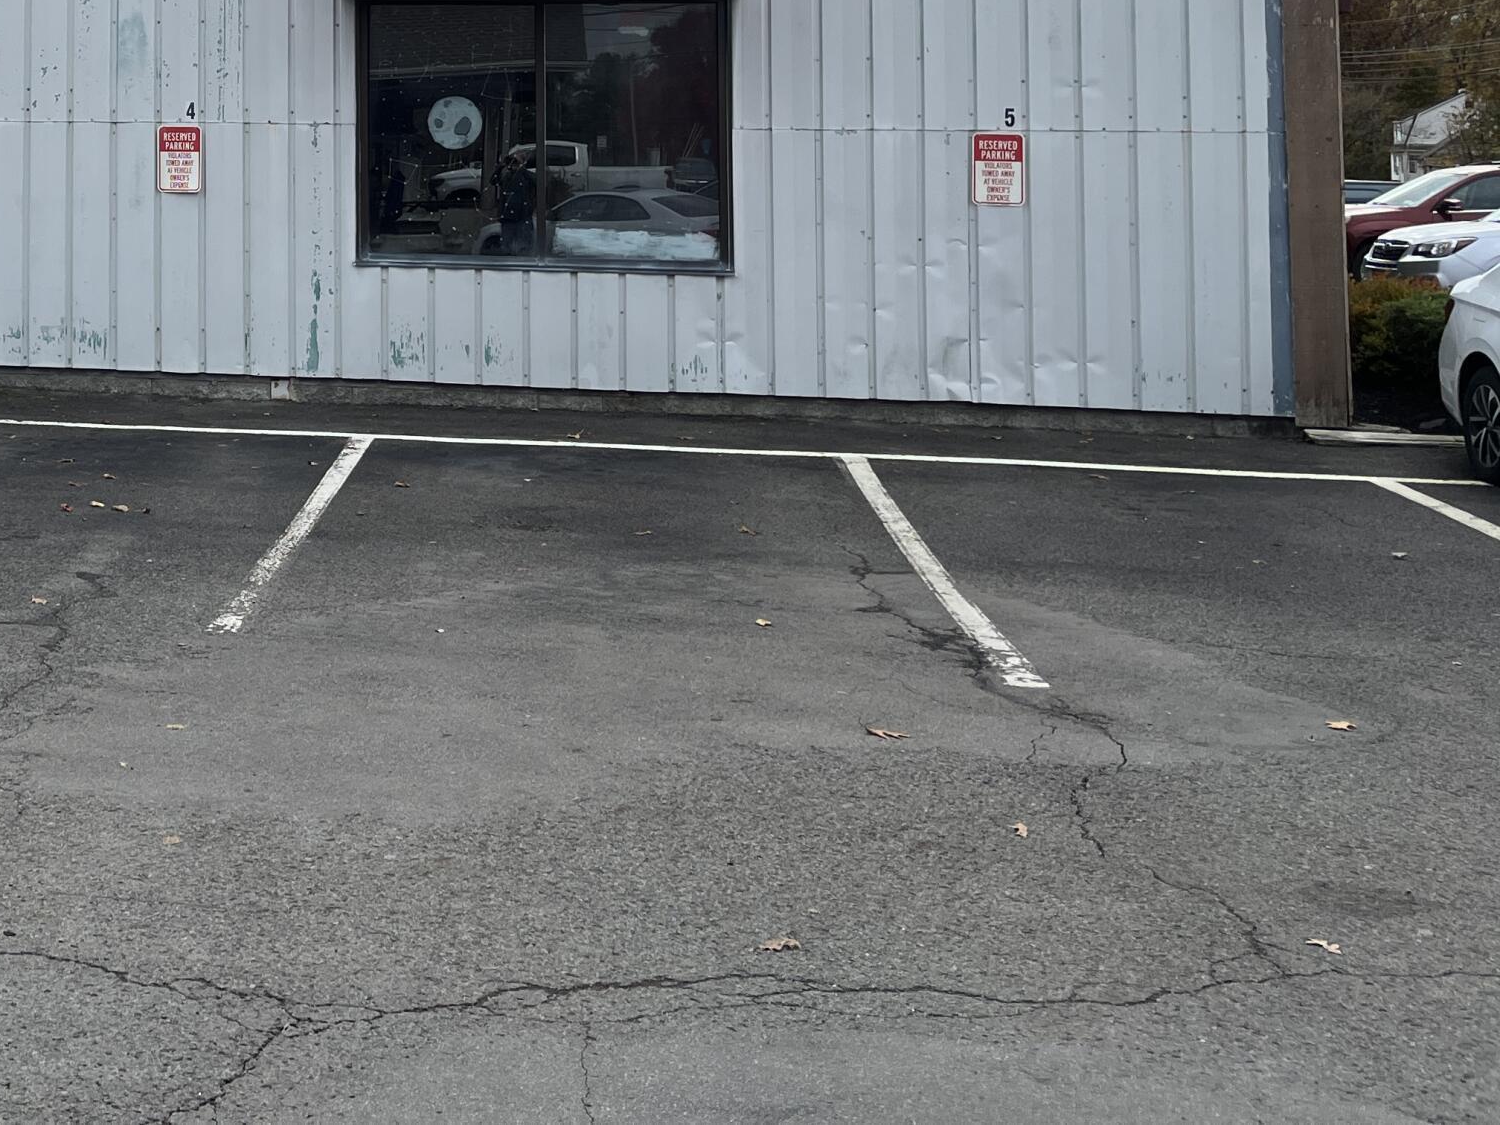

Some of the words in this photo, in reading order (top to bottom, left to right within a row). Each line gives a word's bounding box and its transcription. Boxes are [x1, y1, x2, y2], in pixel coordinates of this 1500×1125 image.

[186, 102, 196, 120] 4
[1004, 108, 1015, 127] 5
[163, 132, 196, 141] RESERVED
[165, 142, 194, 151] PARKING
[979, 141, 1018, 151] RESERVED
[981, 151, 1016, 161] PARKING
[991, 178, 1013, 186] VEHICLE
